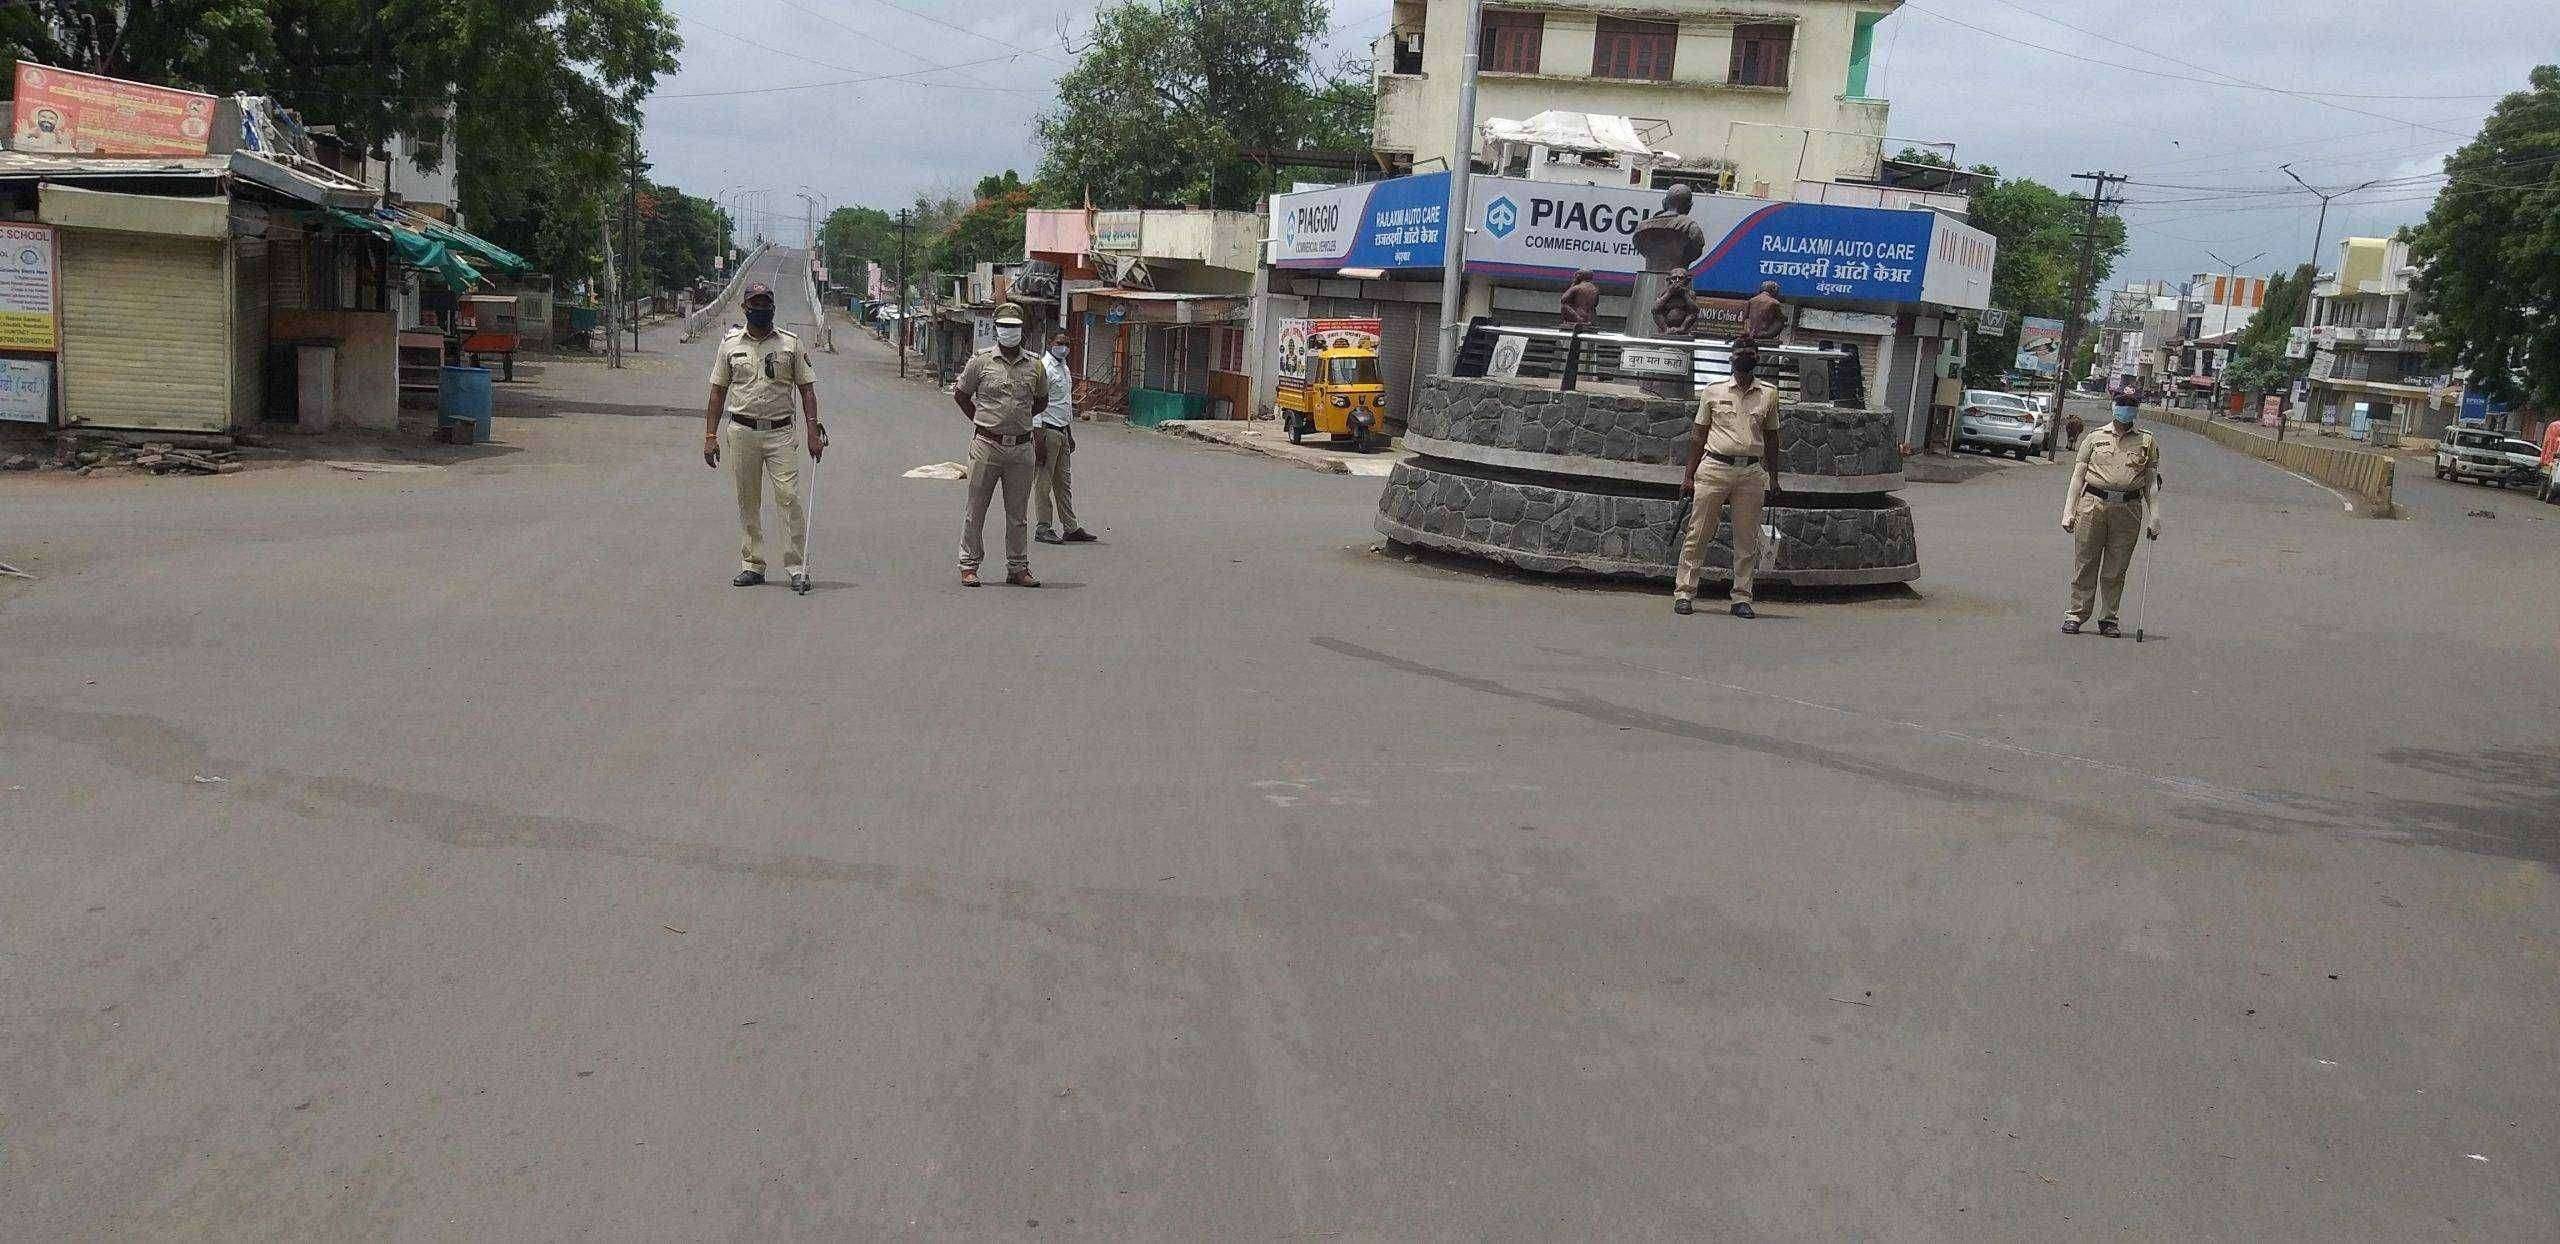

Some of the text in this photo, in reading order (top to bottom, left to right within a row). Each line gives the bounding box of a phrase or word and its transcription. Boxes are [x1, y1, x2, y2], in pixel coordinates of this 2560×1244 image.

[1298, 204, 1339, 233] PIAGGIO
[1404, 207, 1421, 226] AUTO
[1422, 205, 1441, 224] CARE
[1530, 198, 1664, 236] PIAGG
[7, 229, 51, 242] SCHOOL
[1525, 235, 1640, 256] COMMERCIAL VEH
[1762, 235, 1916, 261] RAJLAXMI AUTO CARE
